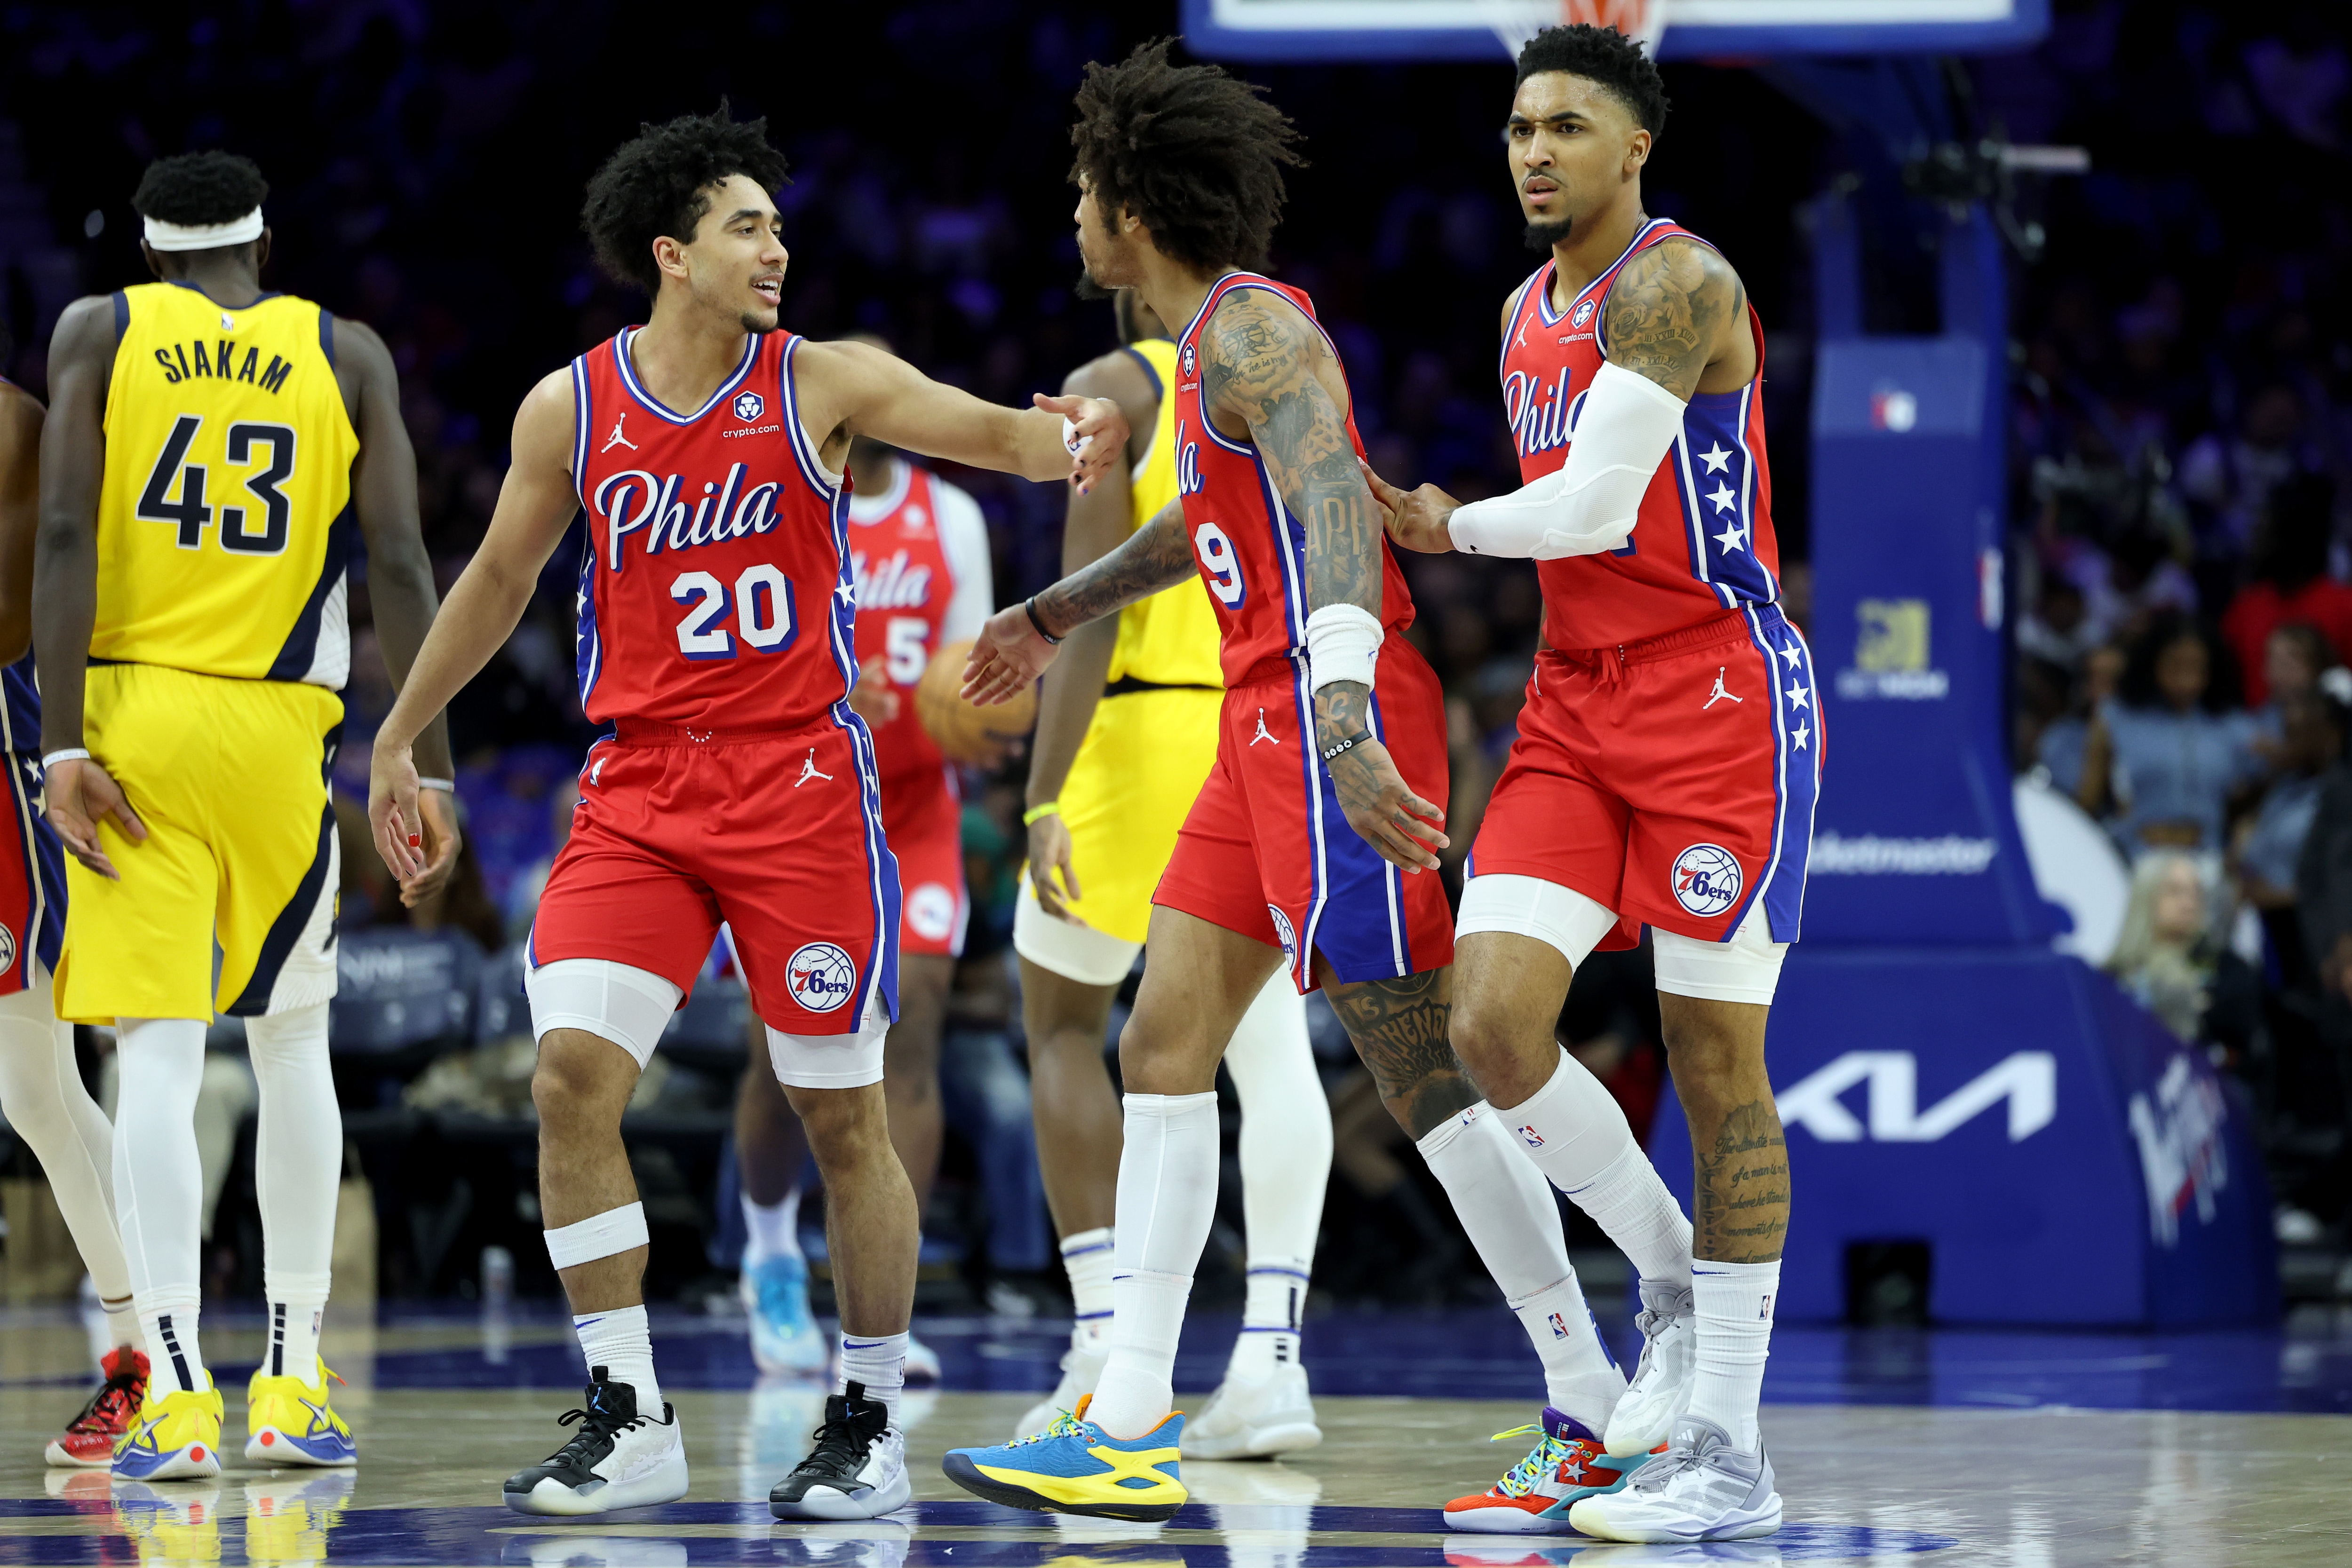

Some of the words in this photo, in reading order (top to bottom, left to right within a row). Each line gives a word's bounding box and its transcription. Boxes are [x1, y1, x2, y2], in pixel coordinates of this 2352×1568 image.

[1559, 333, 1593, 344] crypto.com
[155, 340, 294, 395] SIAKAM
[723, 424, 779, 438] crypto.com
[135, 413, 297, 556] 43
[594, 462, 785, 573] Phila
[852, 547, 933, 610] hila
[670, 563, 799, 661] 20
[885, 616, 931, 686] 5
[1677, 865, 1733, 901] 76ers
[795, 967, 848, 994] 76ers
[1715, 1136, 1735, 1154] The
